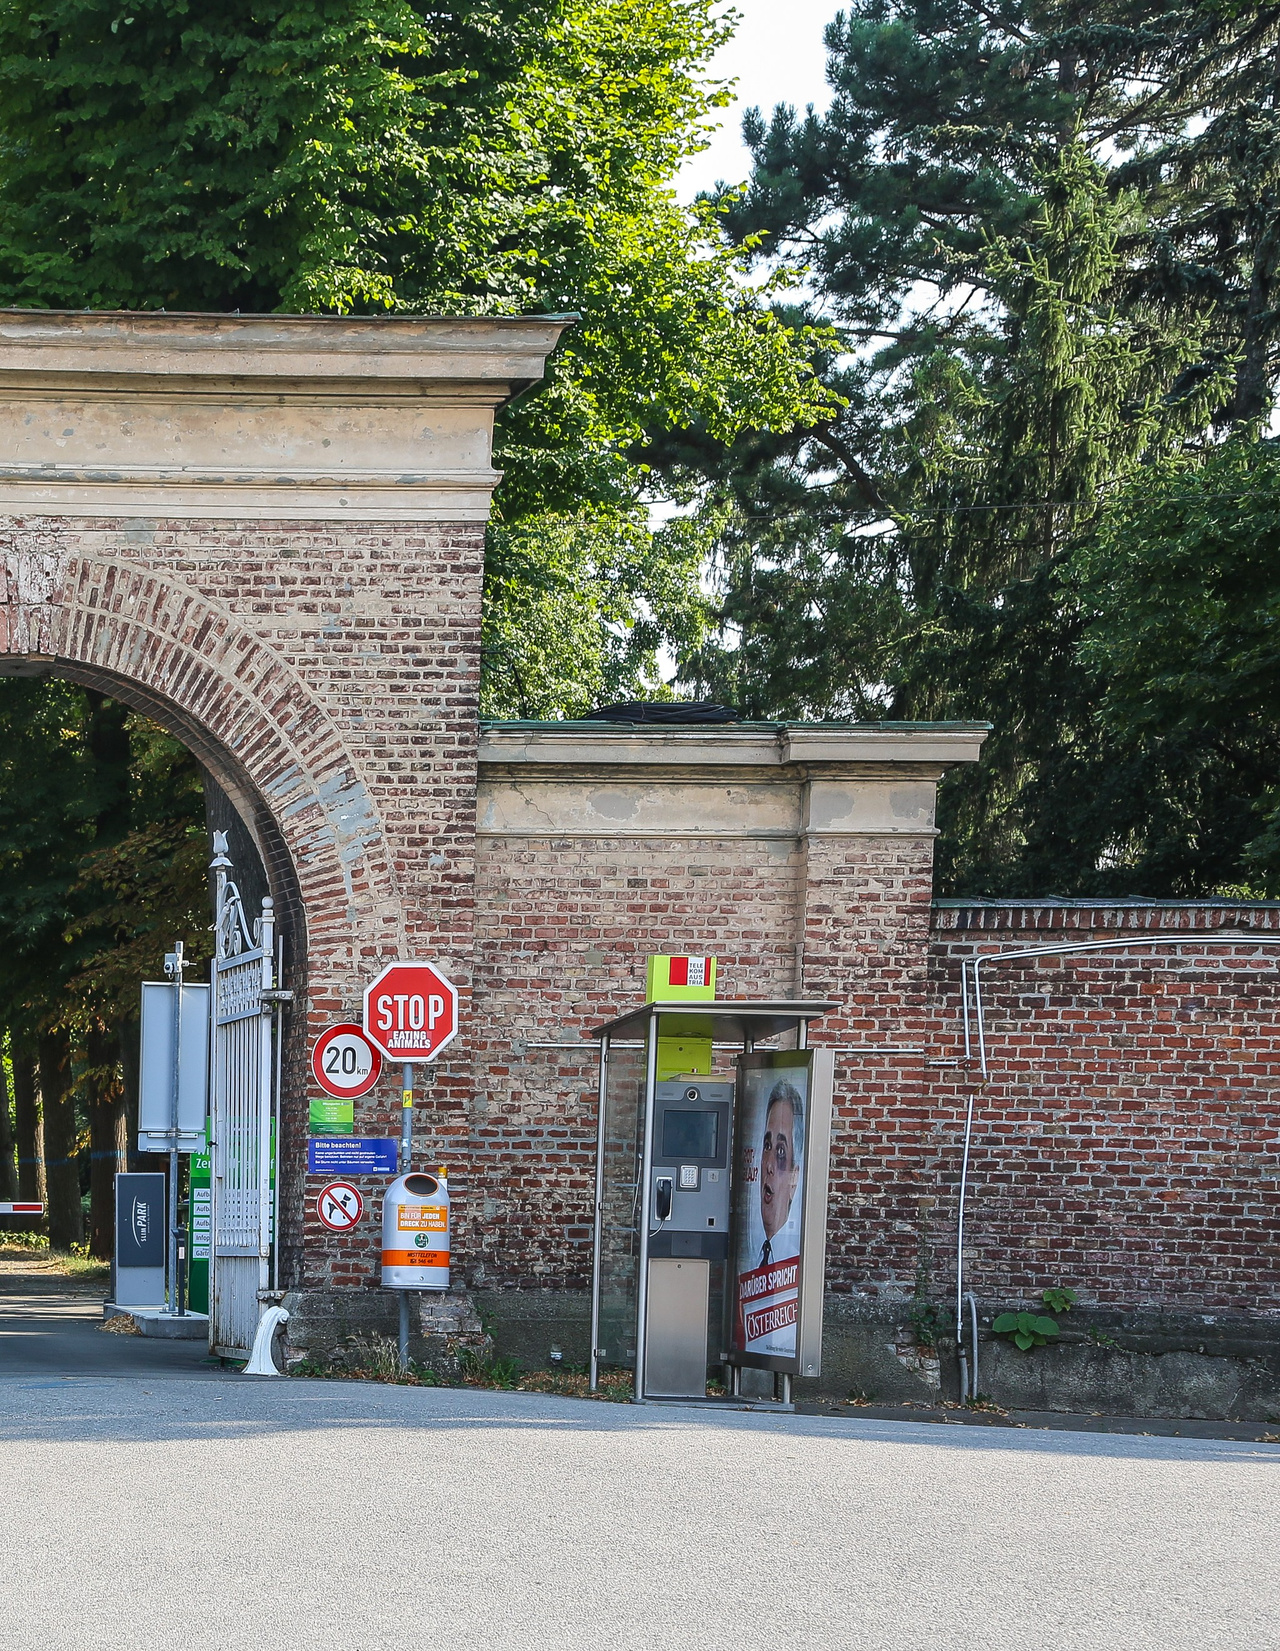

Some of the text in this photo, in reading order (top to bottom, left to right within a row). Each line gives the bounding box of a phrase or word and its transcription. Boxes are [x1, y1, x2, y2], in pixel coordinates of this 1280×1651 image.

[377, 994, 445, 1030] STOP
[387, 1039, 431, 1049] ANIMALS
[393, 1031, 427, 1040] EATING
[326, 1046, 369, 1075] 20 km
[136, 1201, 147, 1227] PARK
[410, 1212, 422, 1220] FÜR
[739, 1265, 798, 1300] DARÜBER SPRICHT
